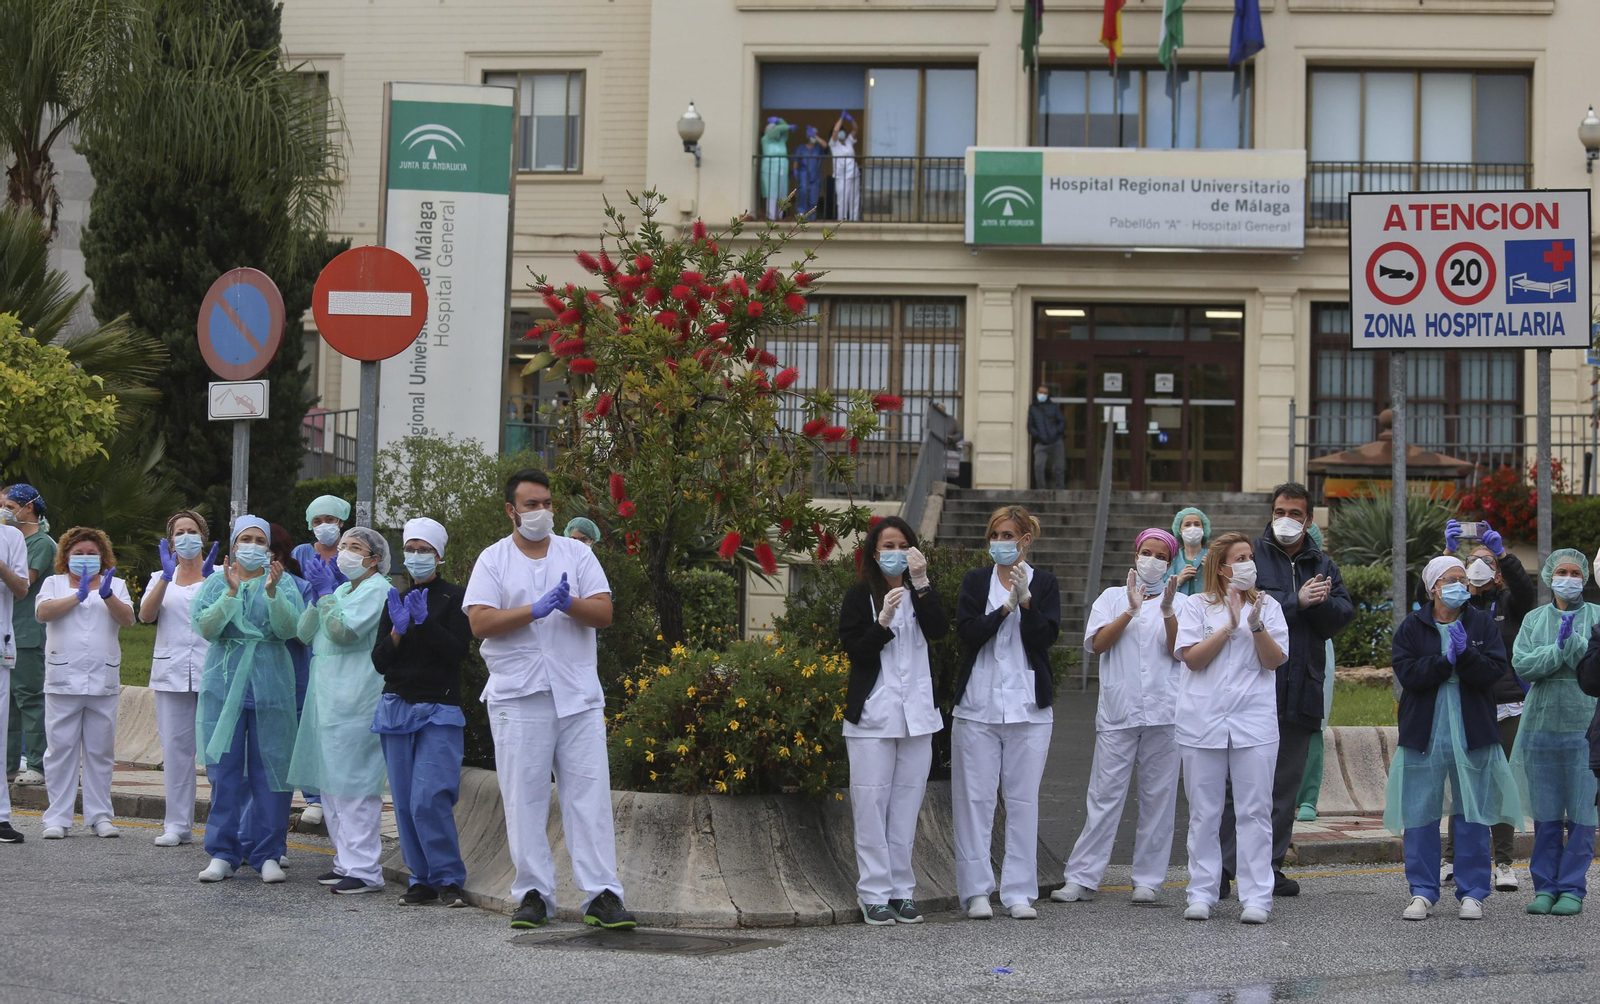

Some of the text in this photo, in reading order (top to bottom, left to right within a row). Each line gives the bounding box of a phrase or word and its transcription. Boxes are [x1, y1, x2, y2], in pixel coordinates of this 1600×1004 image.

[399, 161, 467, 172] JUNTA DE ANDALUCIA
[1050, 177, 1290, 195] Hospital Regional Universitario
[1211, 199, 1290, 216] de Málaga
[1383, 202, 1559, 231] ATENCION
[415, 201, 437, 260] Málaga
[1110, 216, 1160, 230] Pabellón
[1192, 219, 1241, 233] Hospital
[1245, 220, 1291, 233] General
[433, 201, 455, 347] Hospital General
[1450, 258, 1482, 286] 20
[1364, 311, 1566, 338] ZONA HOSPITALARIA
[409, 316, 428, 385] Univers
